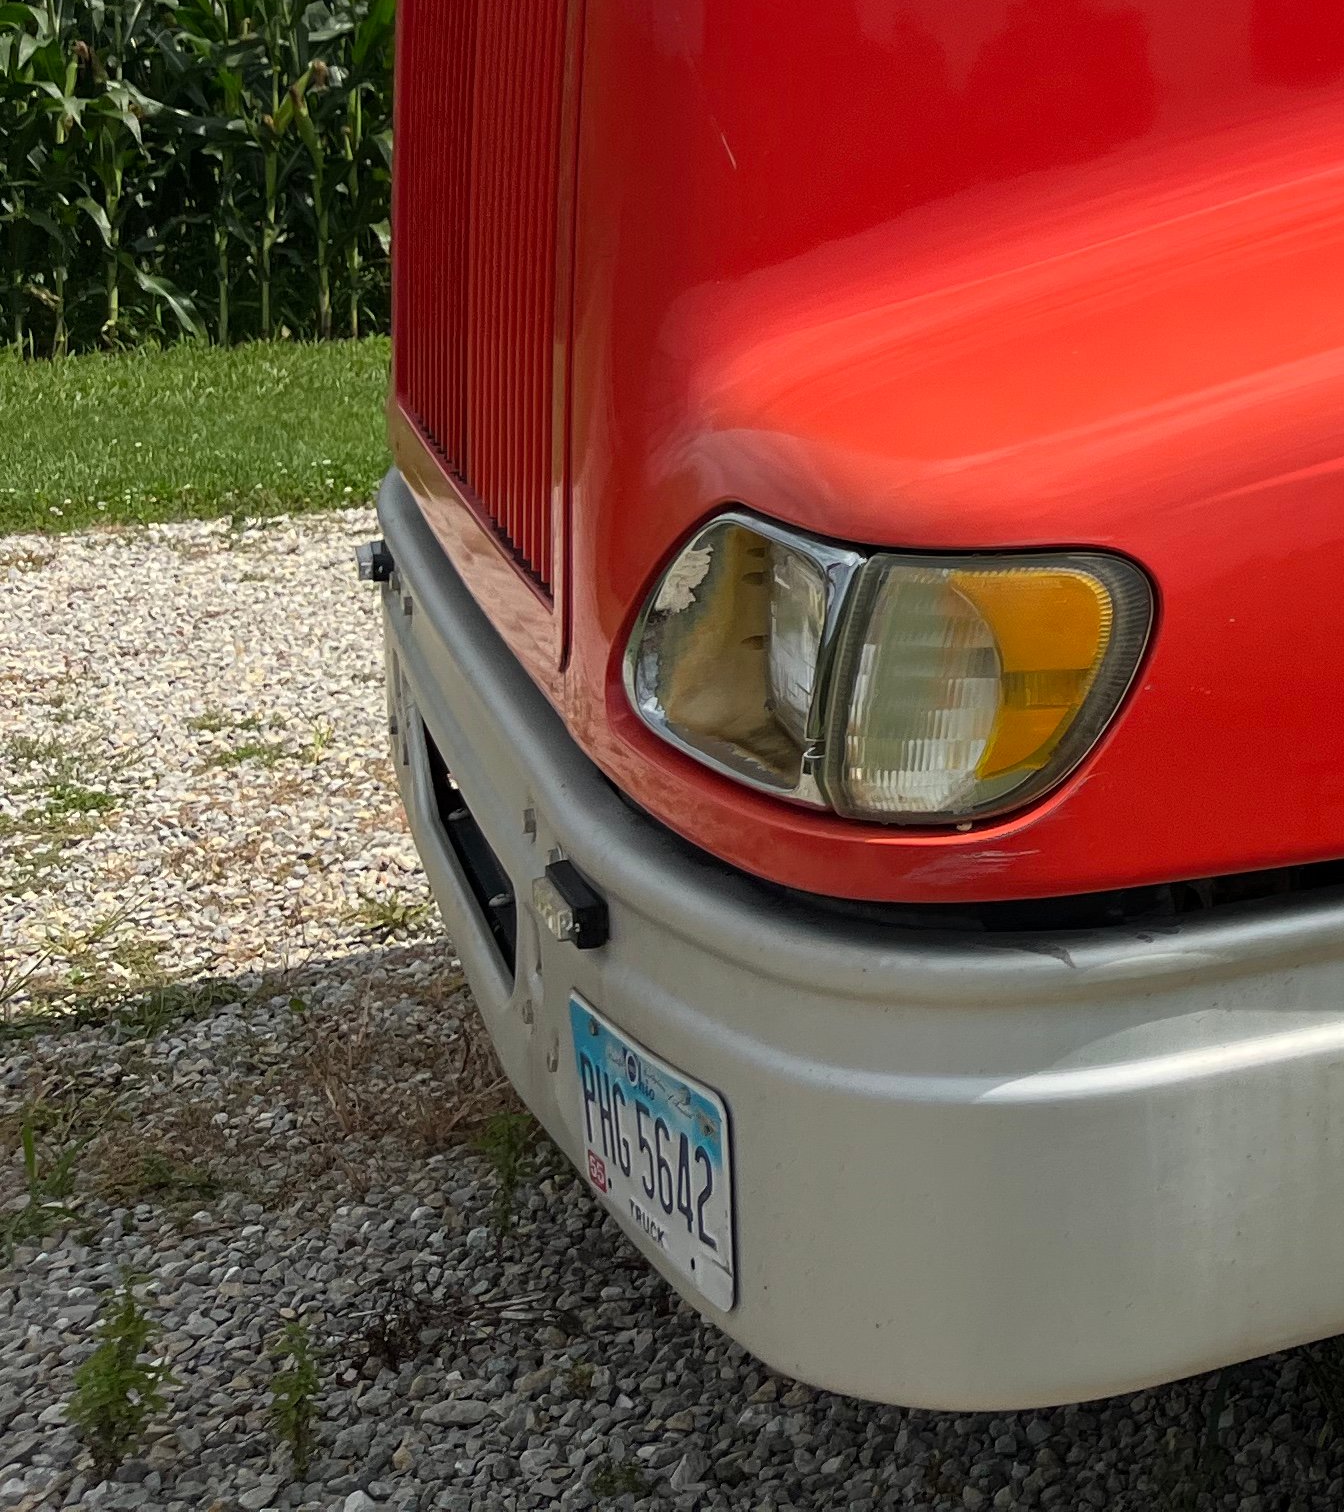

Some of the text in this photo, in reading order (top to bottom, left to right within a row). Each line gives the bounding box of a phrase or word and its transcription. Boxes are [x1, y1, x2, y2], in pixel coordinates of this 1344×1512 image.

[625, 1049, 655, 1101] Ohio
[579, 1051, 718, 1252] PHG 5642
[589, 1157, 606, 1187] 55
[628, 1198, 666, 1249] TRUCK
